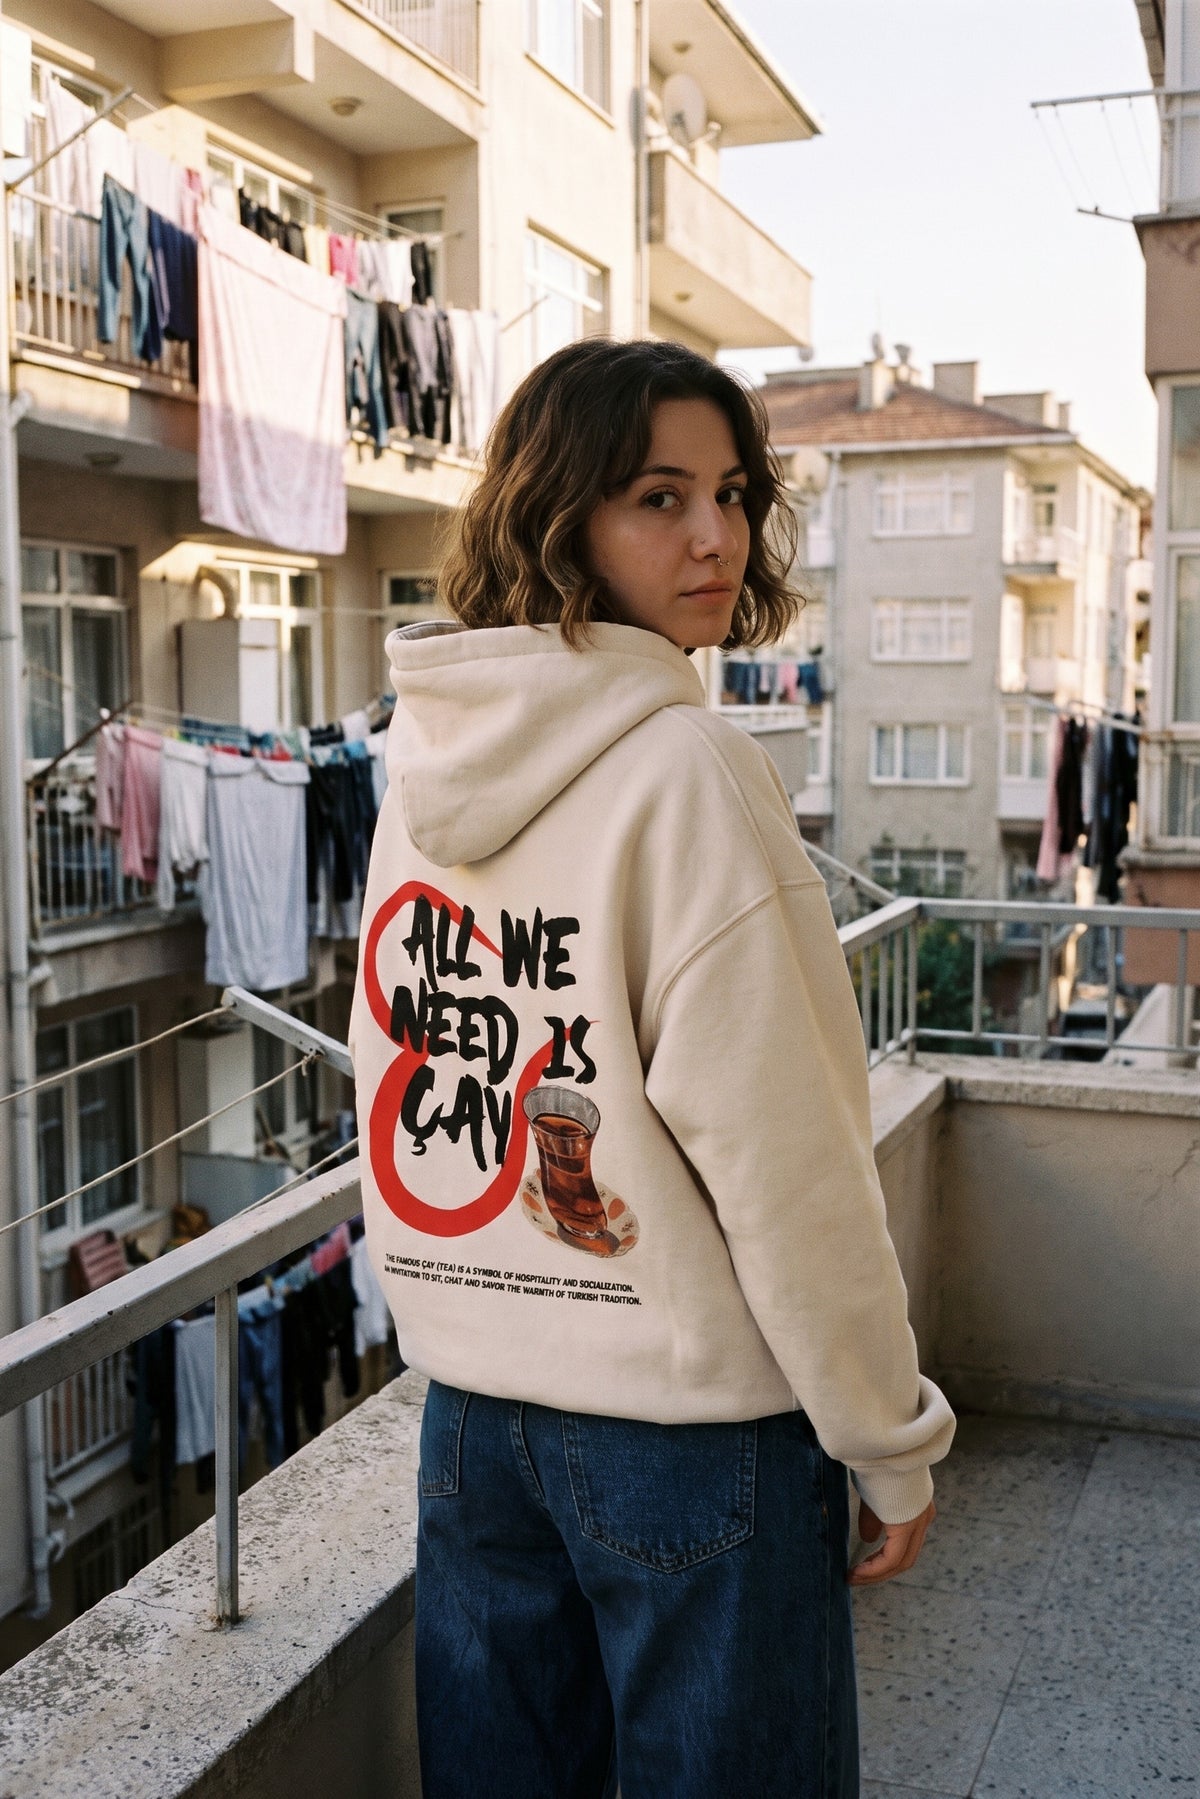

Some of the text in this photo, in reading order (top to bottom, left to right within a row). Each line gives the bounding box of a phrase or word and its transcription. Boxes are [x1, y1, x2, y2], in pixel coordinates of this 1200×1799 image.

[401, 893, 580, 992] ALL WE
[390, 977, 597, 1085] NEED IS
[400, 1064, 512, 1172] ÇAY
[386, 1253, 635, 1293] THE FAMOUS ÇAY (TEA) IS A SYMBOL OF HOSPITALITY AND SOCIALIZATION.
[421, 1272, 430, 1281] TO
[431, 1273, 443, 1284] SIT,
[444, 1275, 463, 1285] CHAT
[463, 1278, 480, 1288] AND
[481, 1280, 505, 1291] SAVOR
[506, 1283, 521, 1294] THE
[555, 1289, 566, 1299] OF
[567, 1290, 599, 1302] TURKISH
[599, 1293, 642, 1306] TRADITION.
